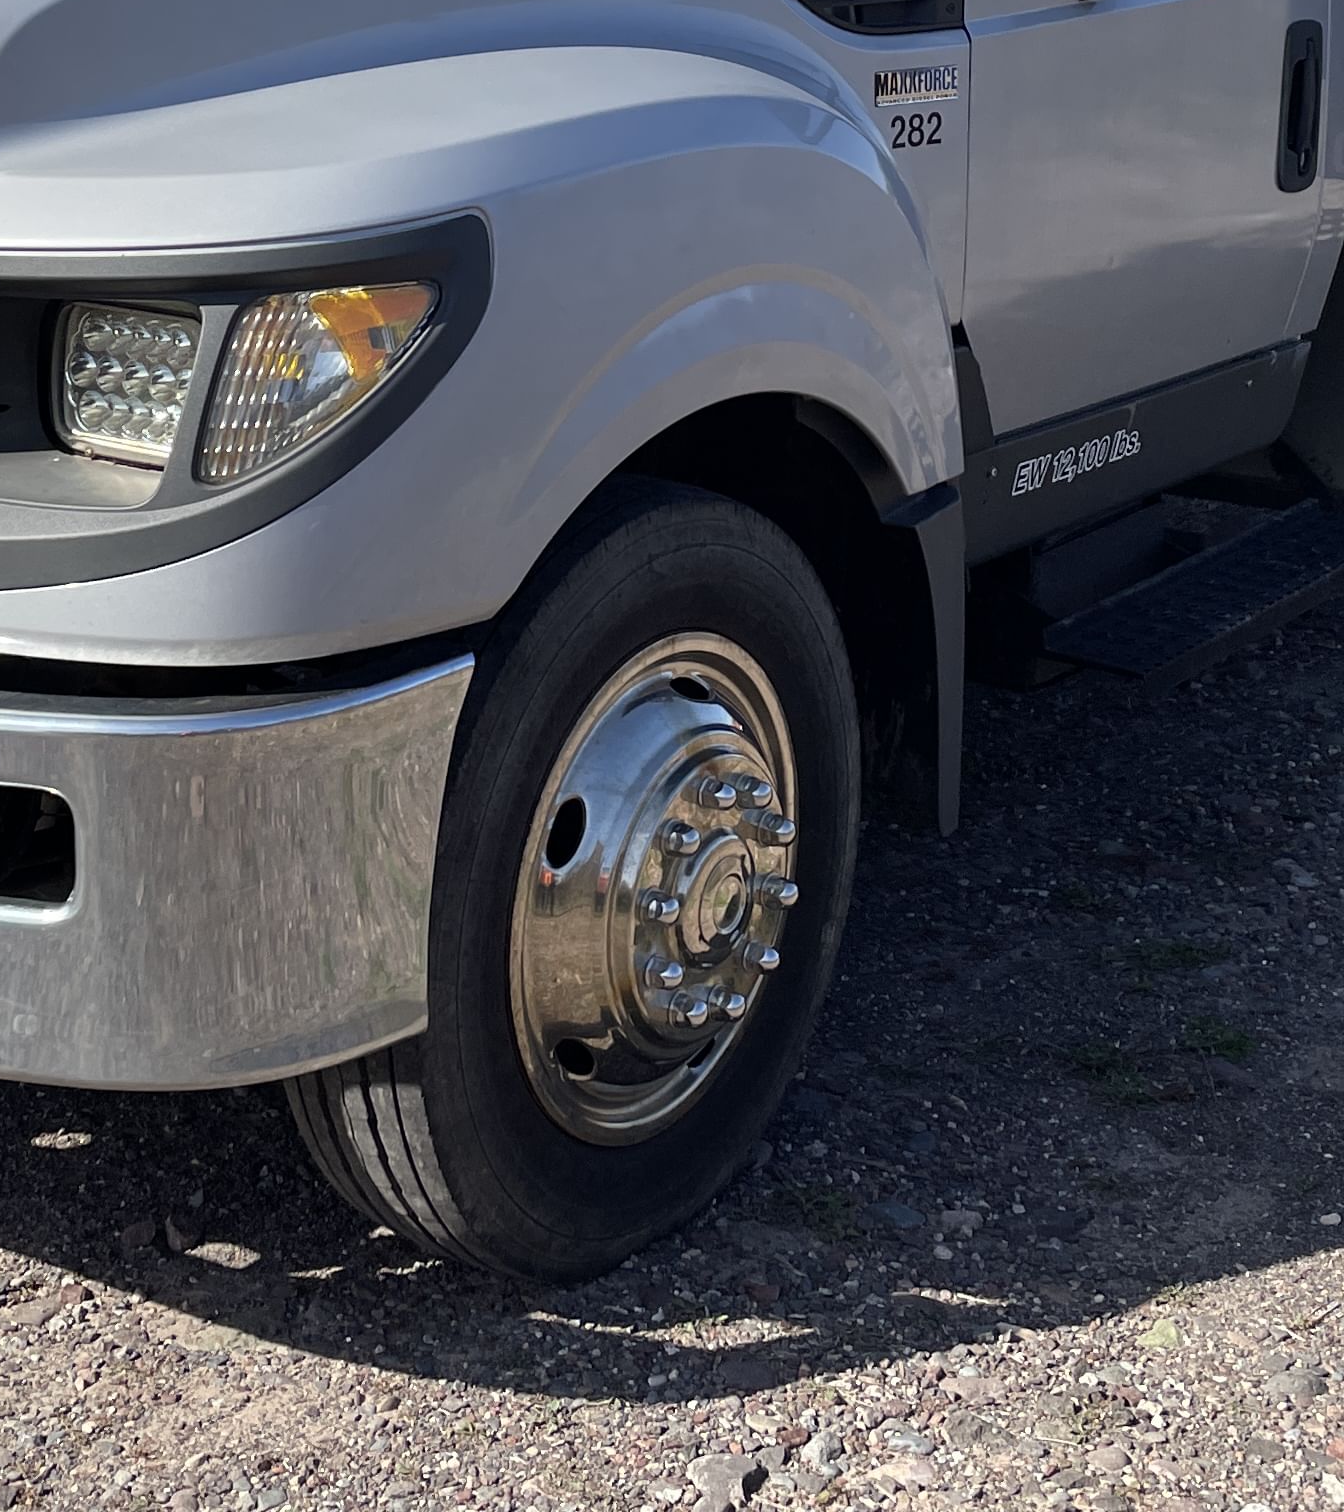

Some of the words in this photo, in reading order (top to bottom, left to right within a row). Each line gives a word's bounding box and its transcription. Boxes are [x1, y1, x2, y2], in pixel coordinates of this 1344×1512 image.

[874, 67, 958, 97] MAXXFORCE
[891, 112, 942, 149] 282
[1012, 454, 1052, 496] EW
[1052, 436, 1111, 483] 12,100
[1109, 429, 1141, 463] lbs.
